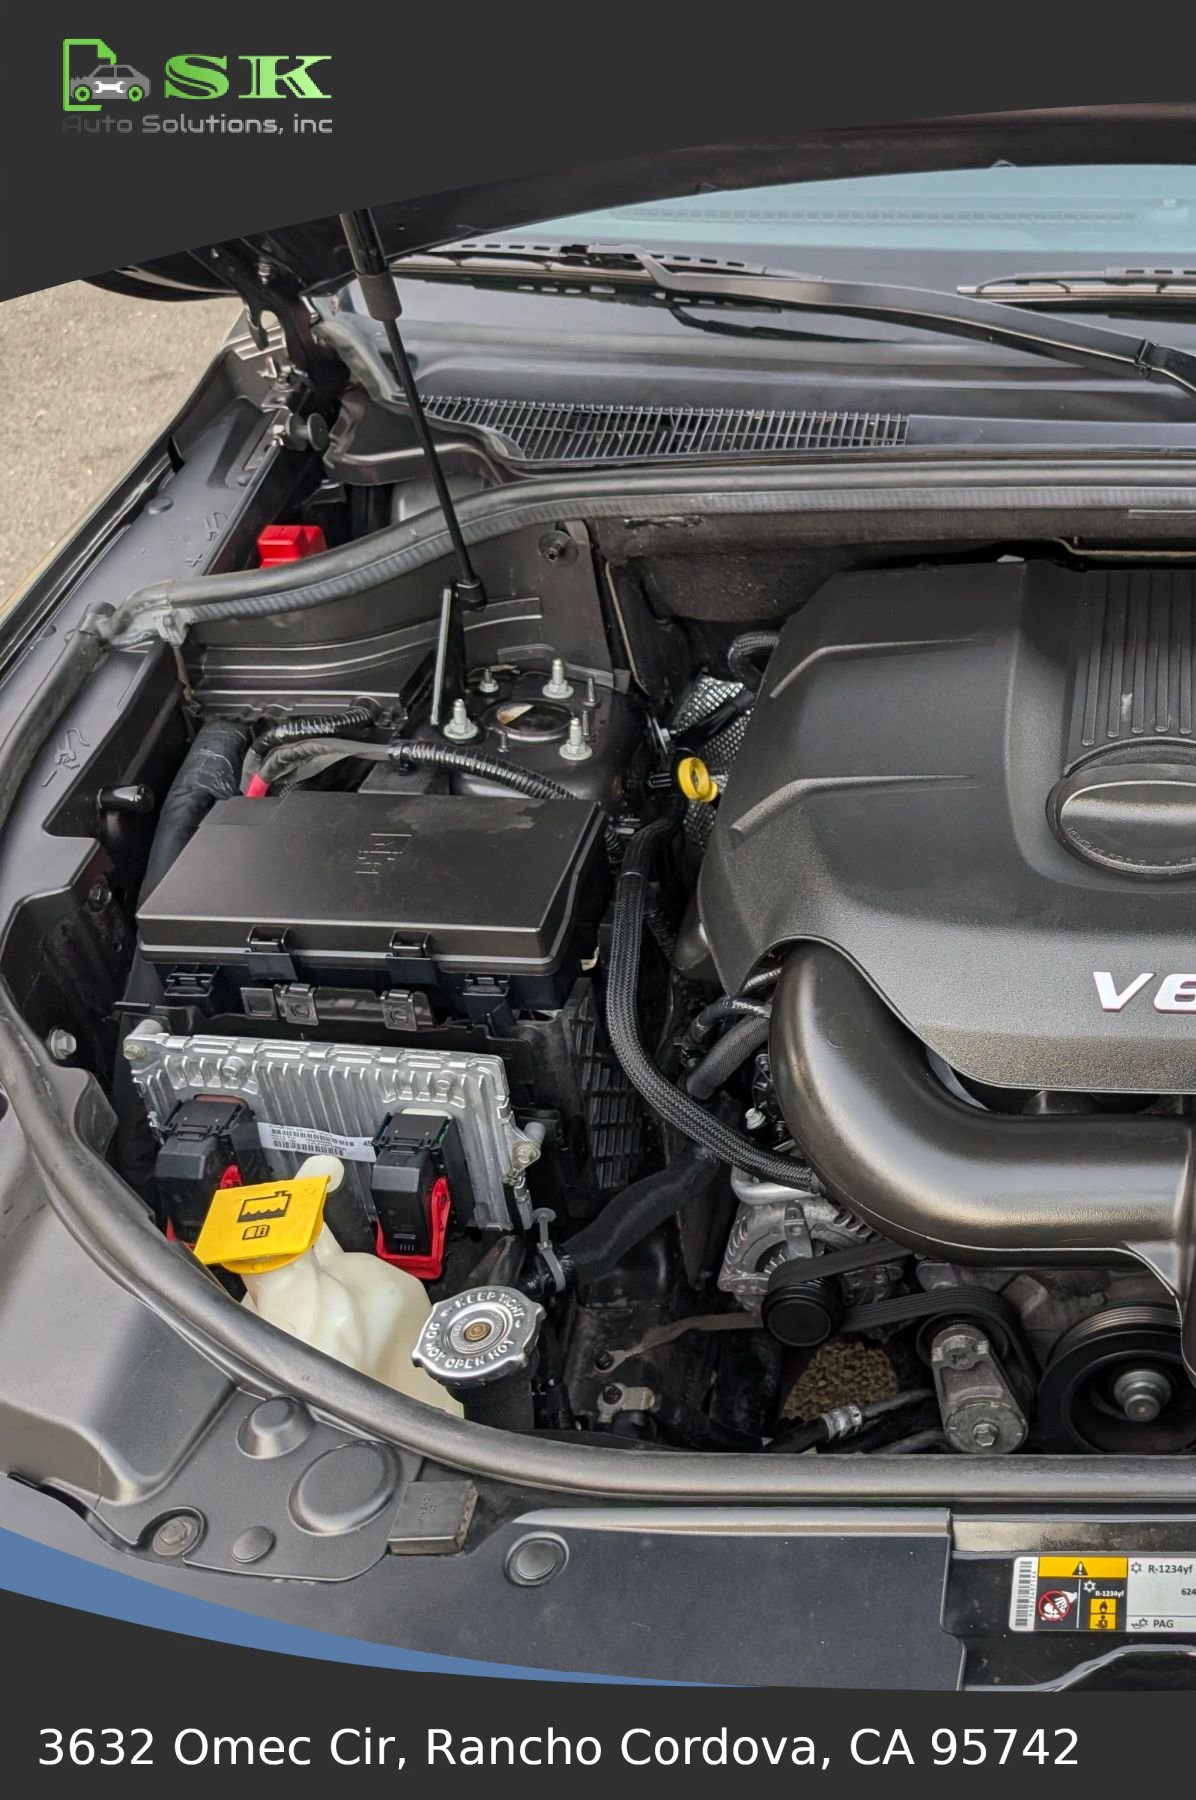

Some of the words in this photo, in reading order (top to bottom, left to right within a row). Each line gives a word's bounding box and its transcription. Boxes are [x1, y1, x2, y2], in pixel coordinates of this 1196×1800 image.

[455, 1291, 497, 1309] KEEP
[445, 1355, 486, 1369] OPEN
[487, 1339, 516, 1360] HOT
[1148, 1564, 1193, 1575] R-1234yf
[1095, 1590, 1125, 1598] R-1234yf
[1153, 1619, 1174, 1628] PAG
